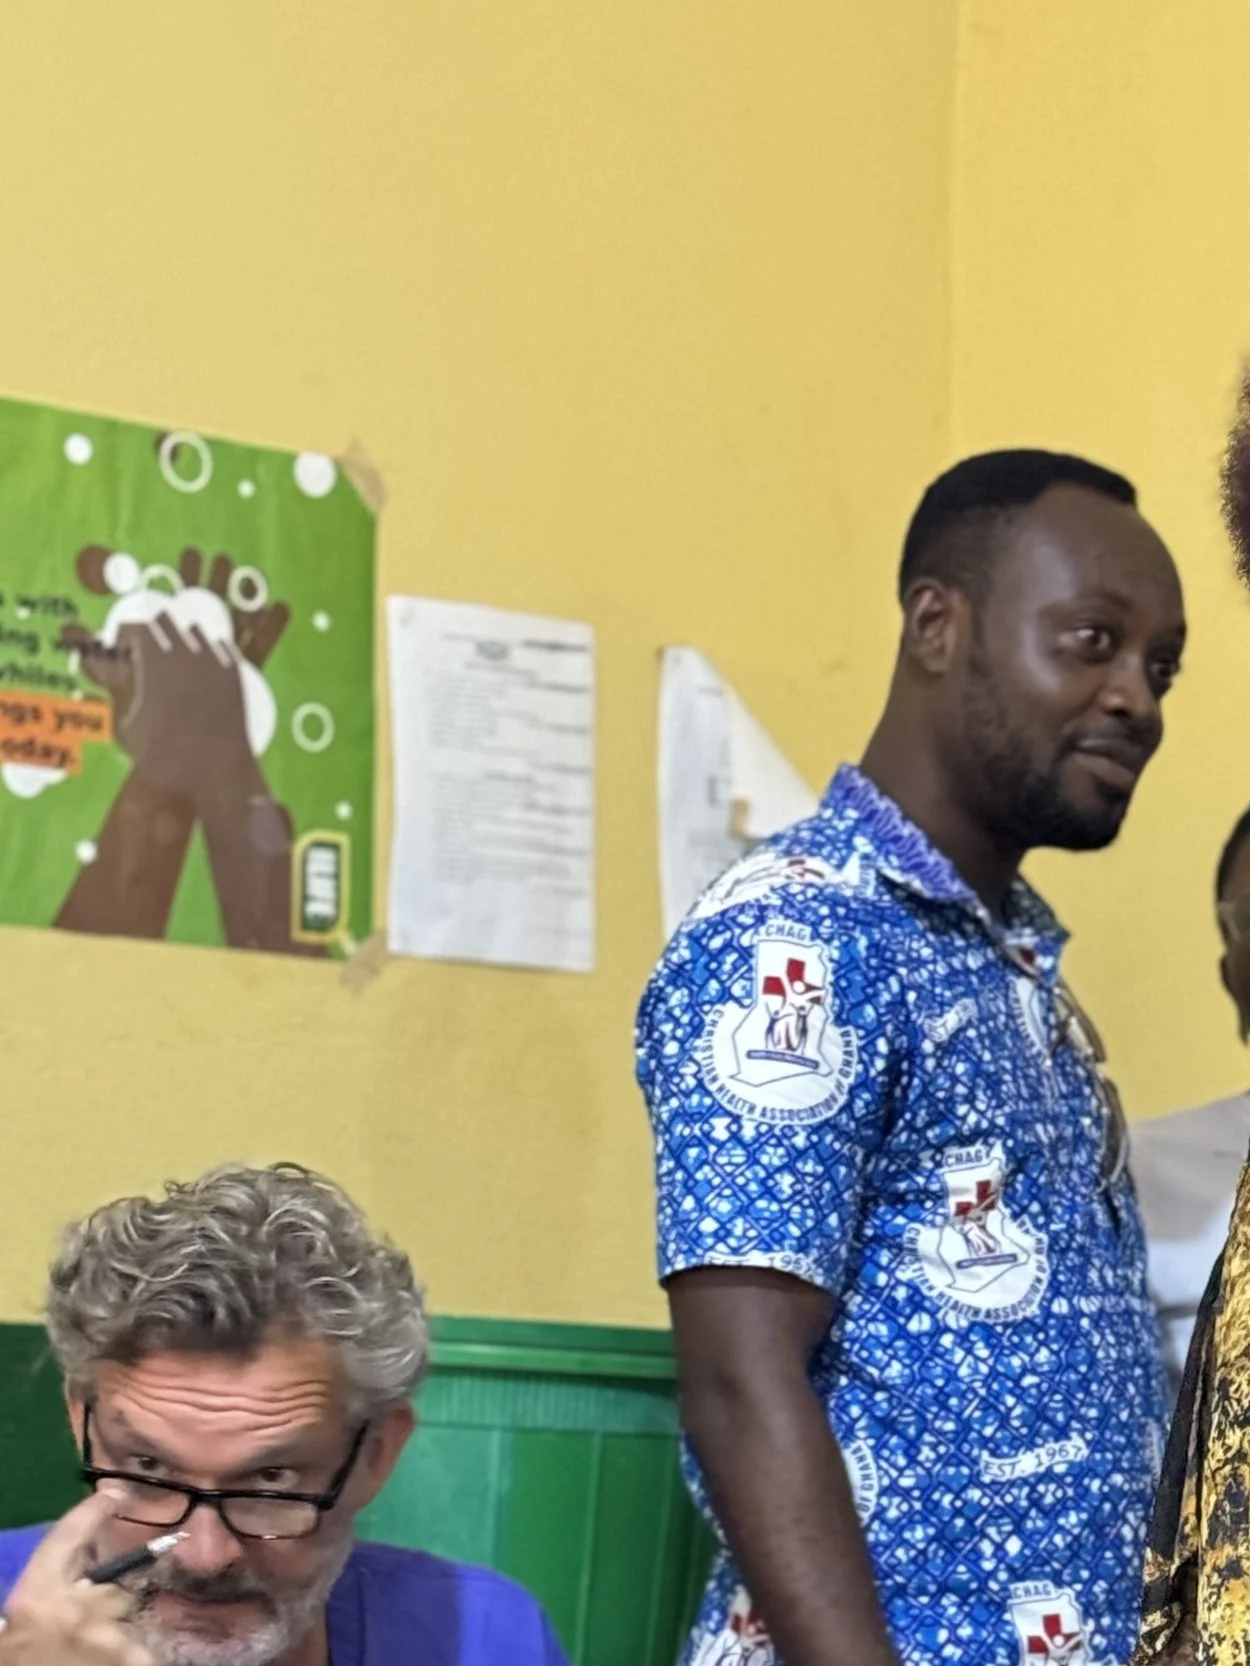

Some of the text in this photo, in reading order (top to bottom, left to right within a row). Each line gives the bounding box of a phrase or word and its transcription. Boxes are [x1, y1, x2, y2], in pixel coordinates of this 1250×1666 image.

[765, 923, 807, 941] CHAG
[701, 1008, 725, 1084] CHRISTIAN
[715, 1082, 757, 1115] HEALTH
[838, 1029, 852, 1080] GHANA
[945, 1149, 983, 1167] CHAG
[983, 1445, 1083, 1479] EST. 1967
[1013, 1583, 1050, 1597] CHAG
